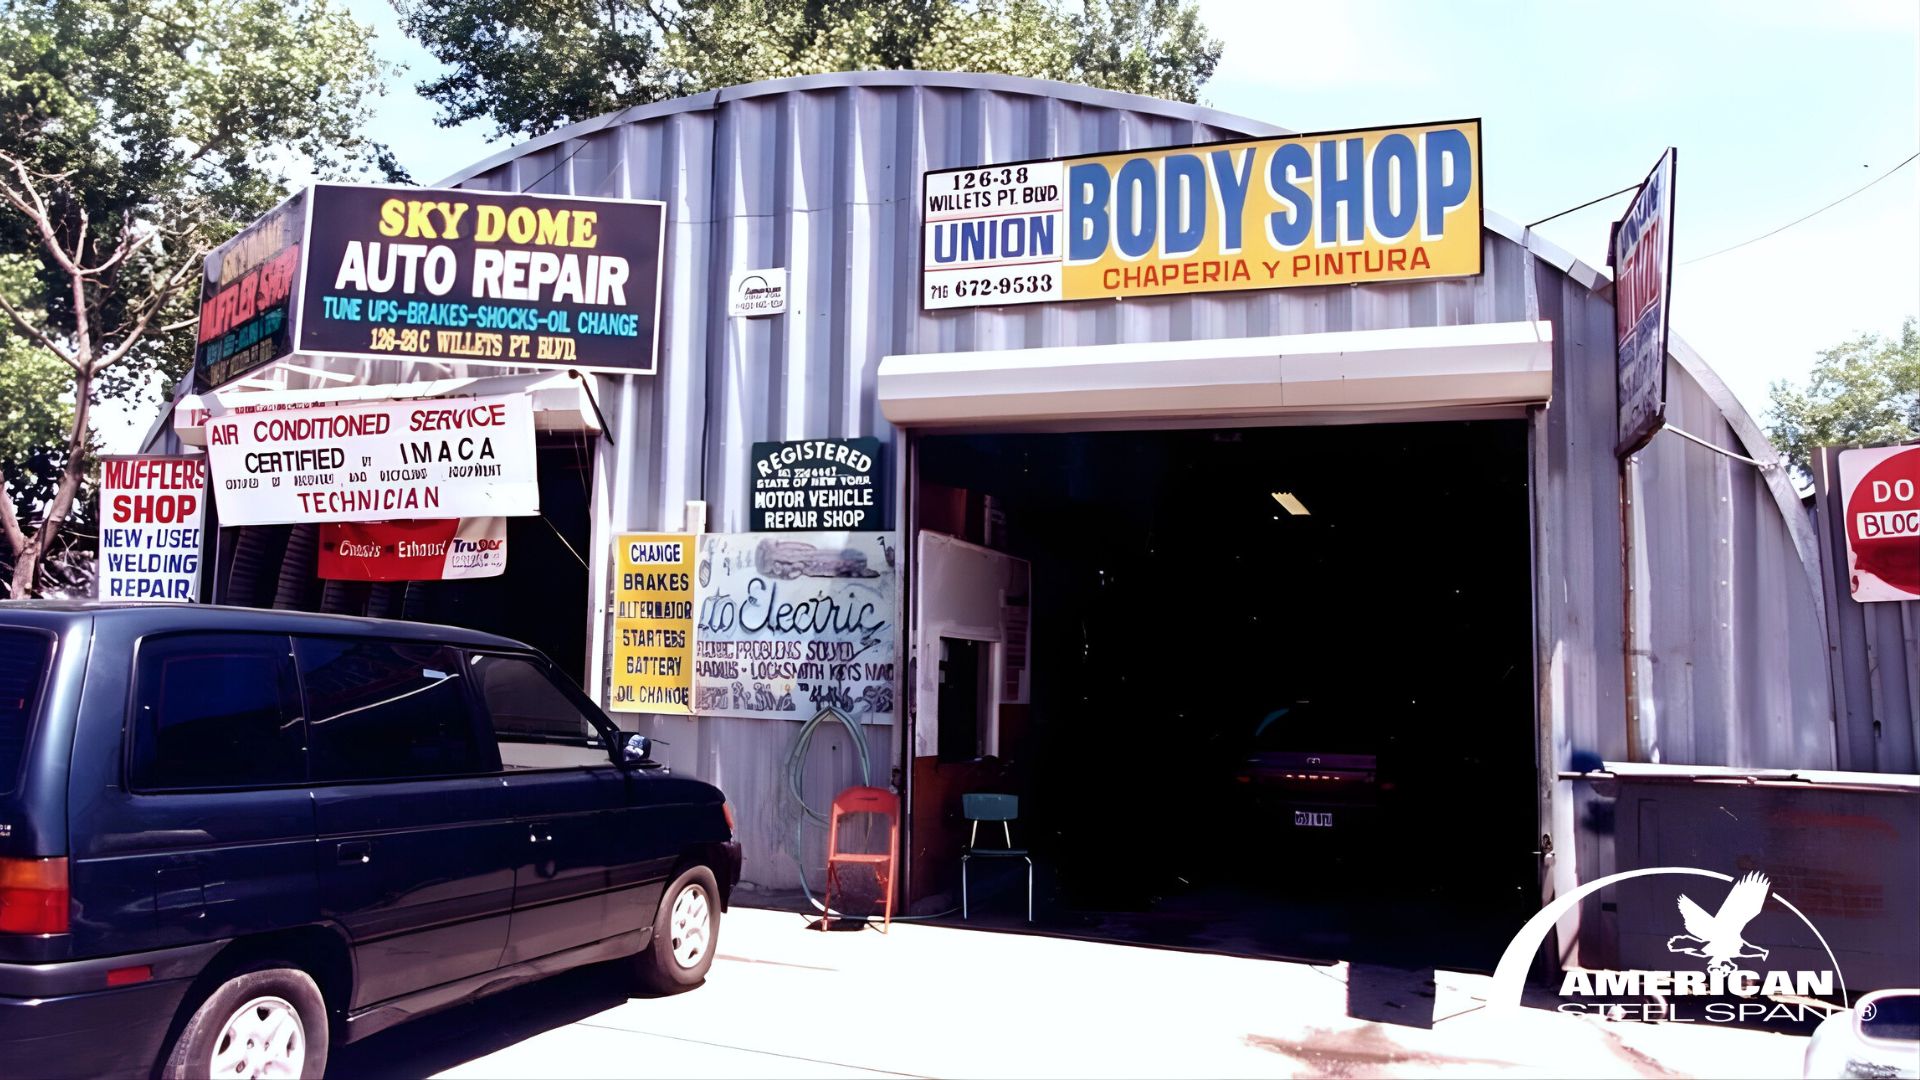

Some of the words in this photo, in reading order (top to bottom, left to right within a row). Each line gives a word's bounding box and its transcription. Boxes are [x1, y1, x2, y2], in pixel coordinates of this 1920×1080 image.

[953, 167, 1028, 190] 126-38
[929, 191, 992, 212] WILLETS
[1066, 147, 1257, 265] BODY
[1264, 129, 1472, 252] SHOP
[379, 198, 469, 239] SKY
[474, 204, 598, 248] DOME
[934, 214, 1054, 263] UNION
[334, 240, 457, 296] AUTO
[472, 248, 630, 306] REPAIR
[1103, 259, 1251, 290] CHAPERIA
[1262, 260, 1280, 279] Y
[1293, 246, 1431, 277] PINTURA
[955, 274, 1052, 297] 672-9533
[323, 296, 361, 321] TUNE
[577, 312, 639, 337] CHANGE
[436, 331, 502, 357] WILLETS
[211, 423, 239, 445] AIR
[253, 413, 390, 442] CONDITIONED
[409, 404, 507, 432] SERVICE
[245, 447, 345, 474] CERTIFIED
[400, 437, 496, 465] IMACA
[756, 441, 872, 478] REGISTERED
[105, 459, 205, 490] MUFFLERS
[297, 486, 440, 514] TECHNICIAN
[755, 490, 805, 509] MOTOR
[808, 488, 874, 507] VEHICLE
[1872, 479, 1914, 503] DO
[113, 494, 197, 524] SHOP
[765, 510, 818, 529] REPAIR
[823, 509, 865, 528] SHOP
[104, 528, 142, 548] NEW
[108, 553, 198, 574] WELDING
[631, 544, 681, 563] CHANGE
[624, 573, 690, 591] BRAKES
[739, 577, 886, 635] Electric
[627, 656, 682, 676] BATTERY
